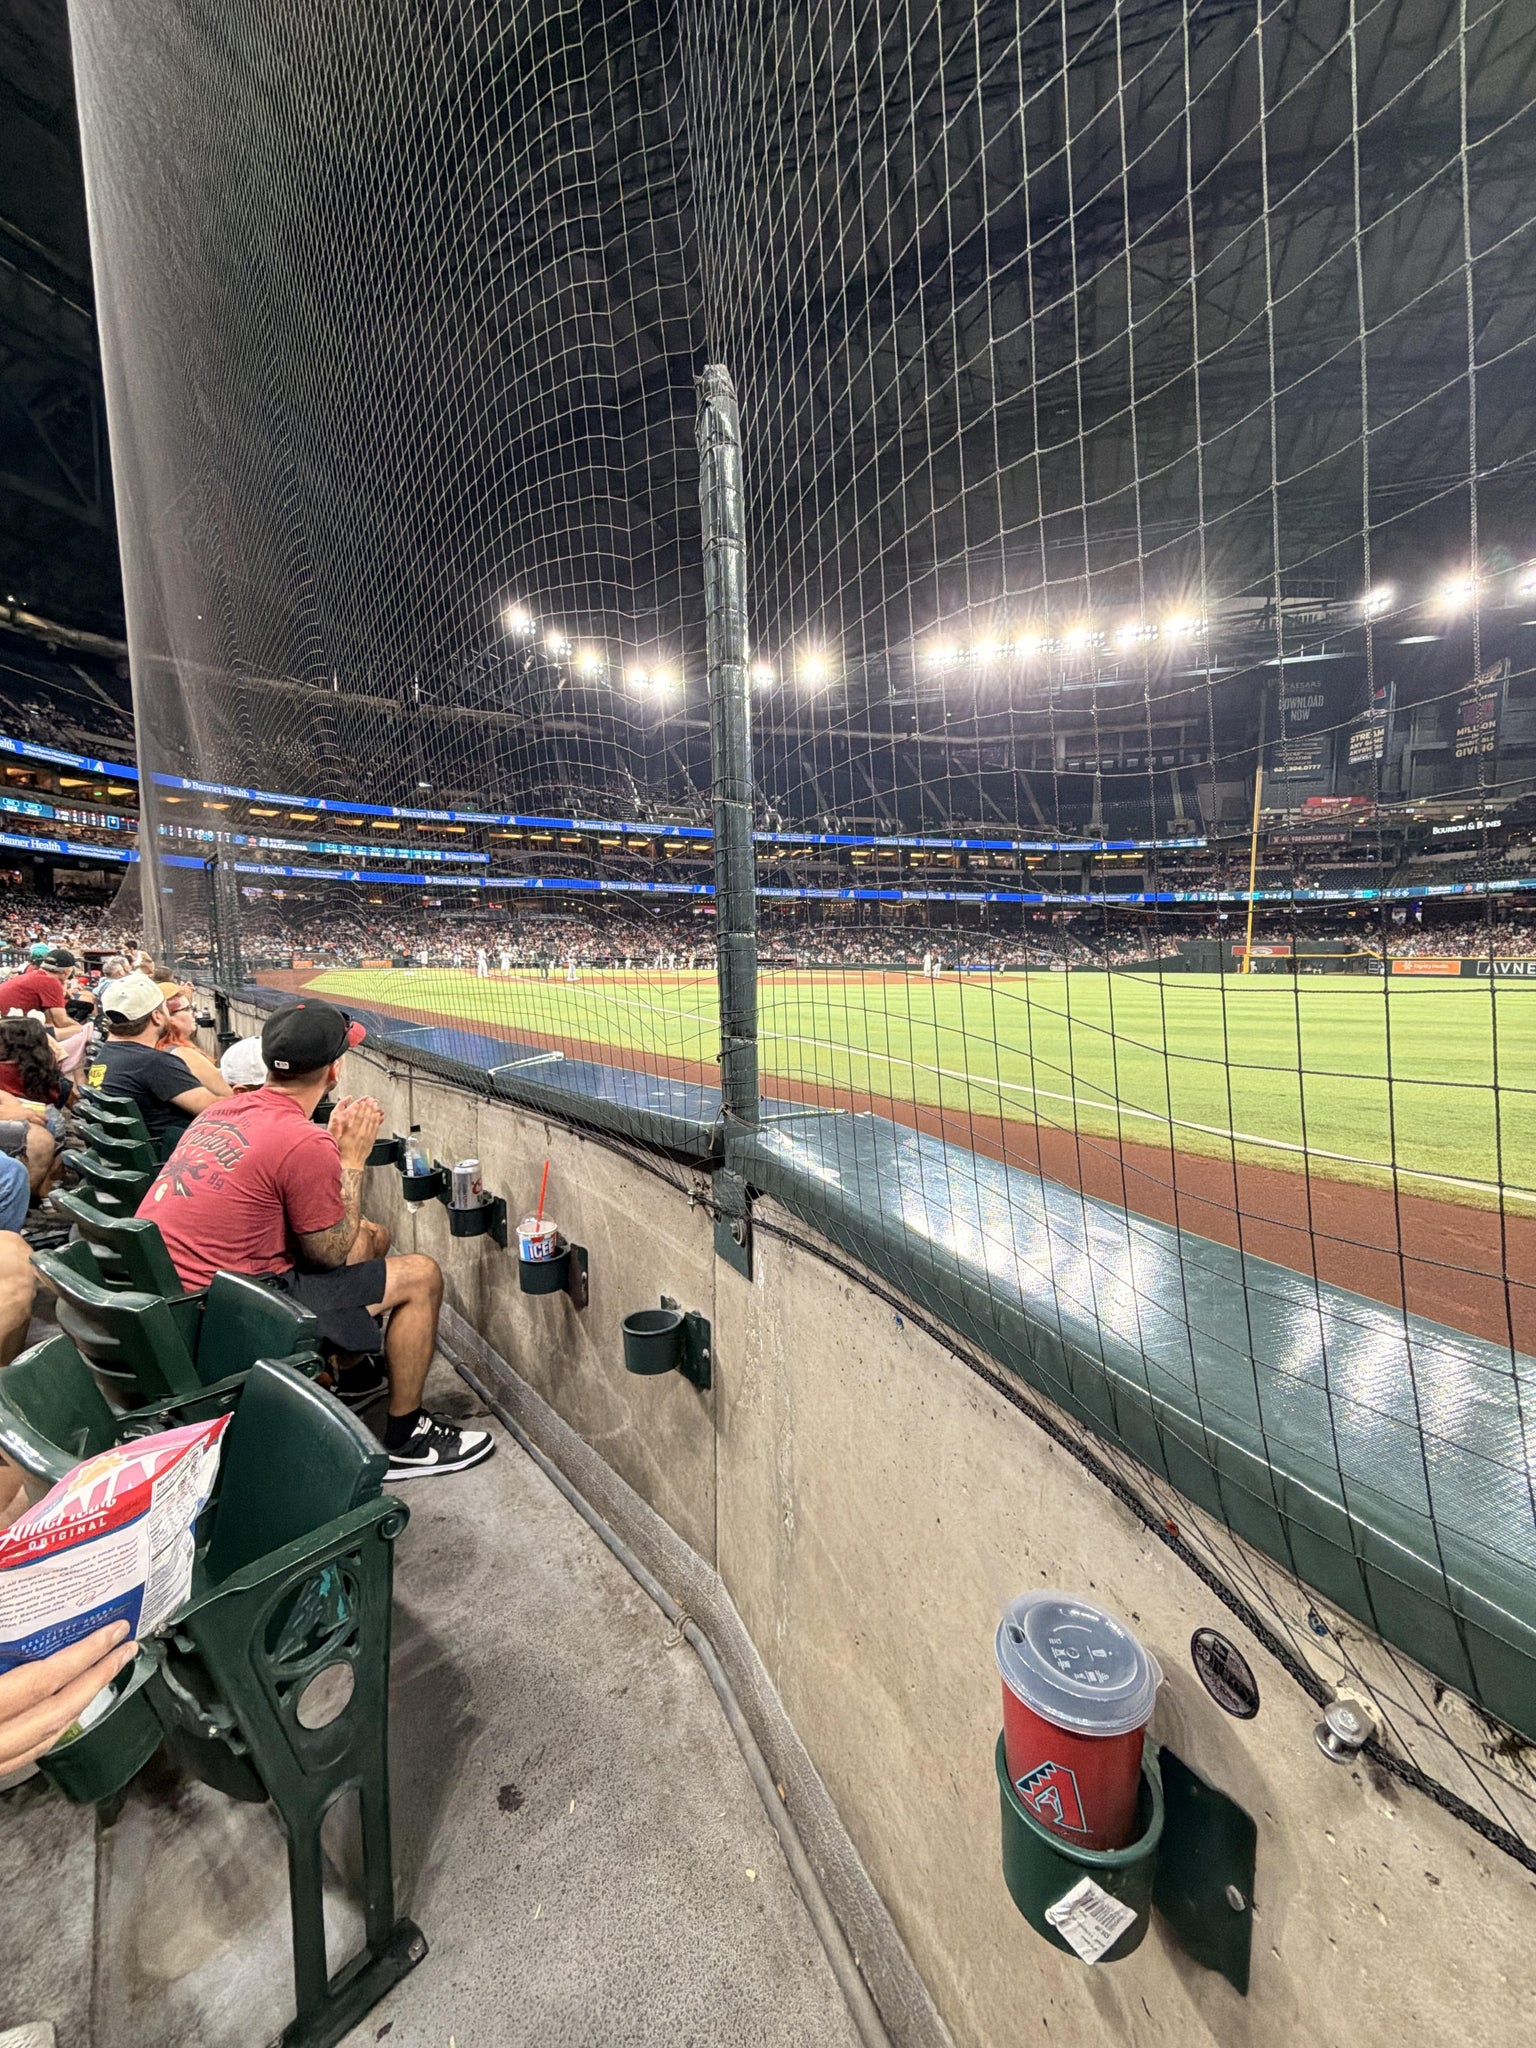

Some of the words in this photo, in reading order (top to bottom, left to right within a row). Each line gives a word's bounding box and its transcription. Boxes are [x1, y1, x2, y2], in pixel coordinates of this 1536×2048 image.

[1290, 708, 1311, 722] NOW
[1456, 720, 1496, 736] MILLON
[1456, 735, 1495, 749] CHARITBLE
[1350, 743, 1384, 756] ANYWHRE
[192, 782, 222, 795] Banner
[223, 786, 250, 799] Health
[401, 809, 427, 818] Banner
[428, 811, 449, 819] Health
[1433, 823, 1467, 834] BOURBON
[1476, 819, 1501, 829] BNES
[0, 834, 29, 846] Banner
[31, 839, 61, 852] Health
[233, 862, 259, 872] anner
[260, 865, 286, 875] Health
[457, 878, 480, 886] Health
[1485, 961, 1536, 975] AVNE
[528, 1240, 557, 1260] ICEE
[28, 1518, 108, 1552] ORIGINAL
